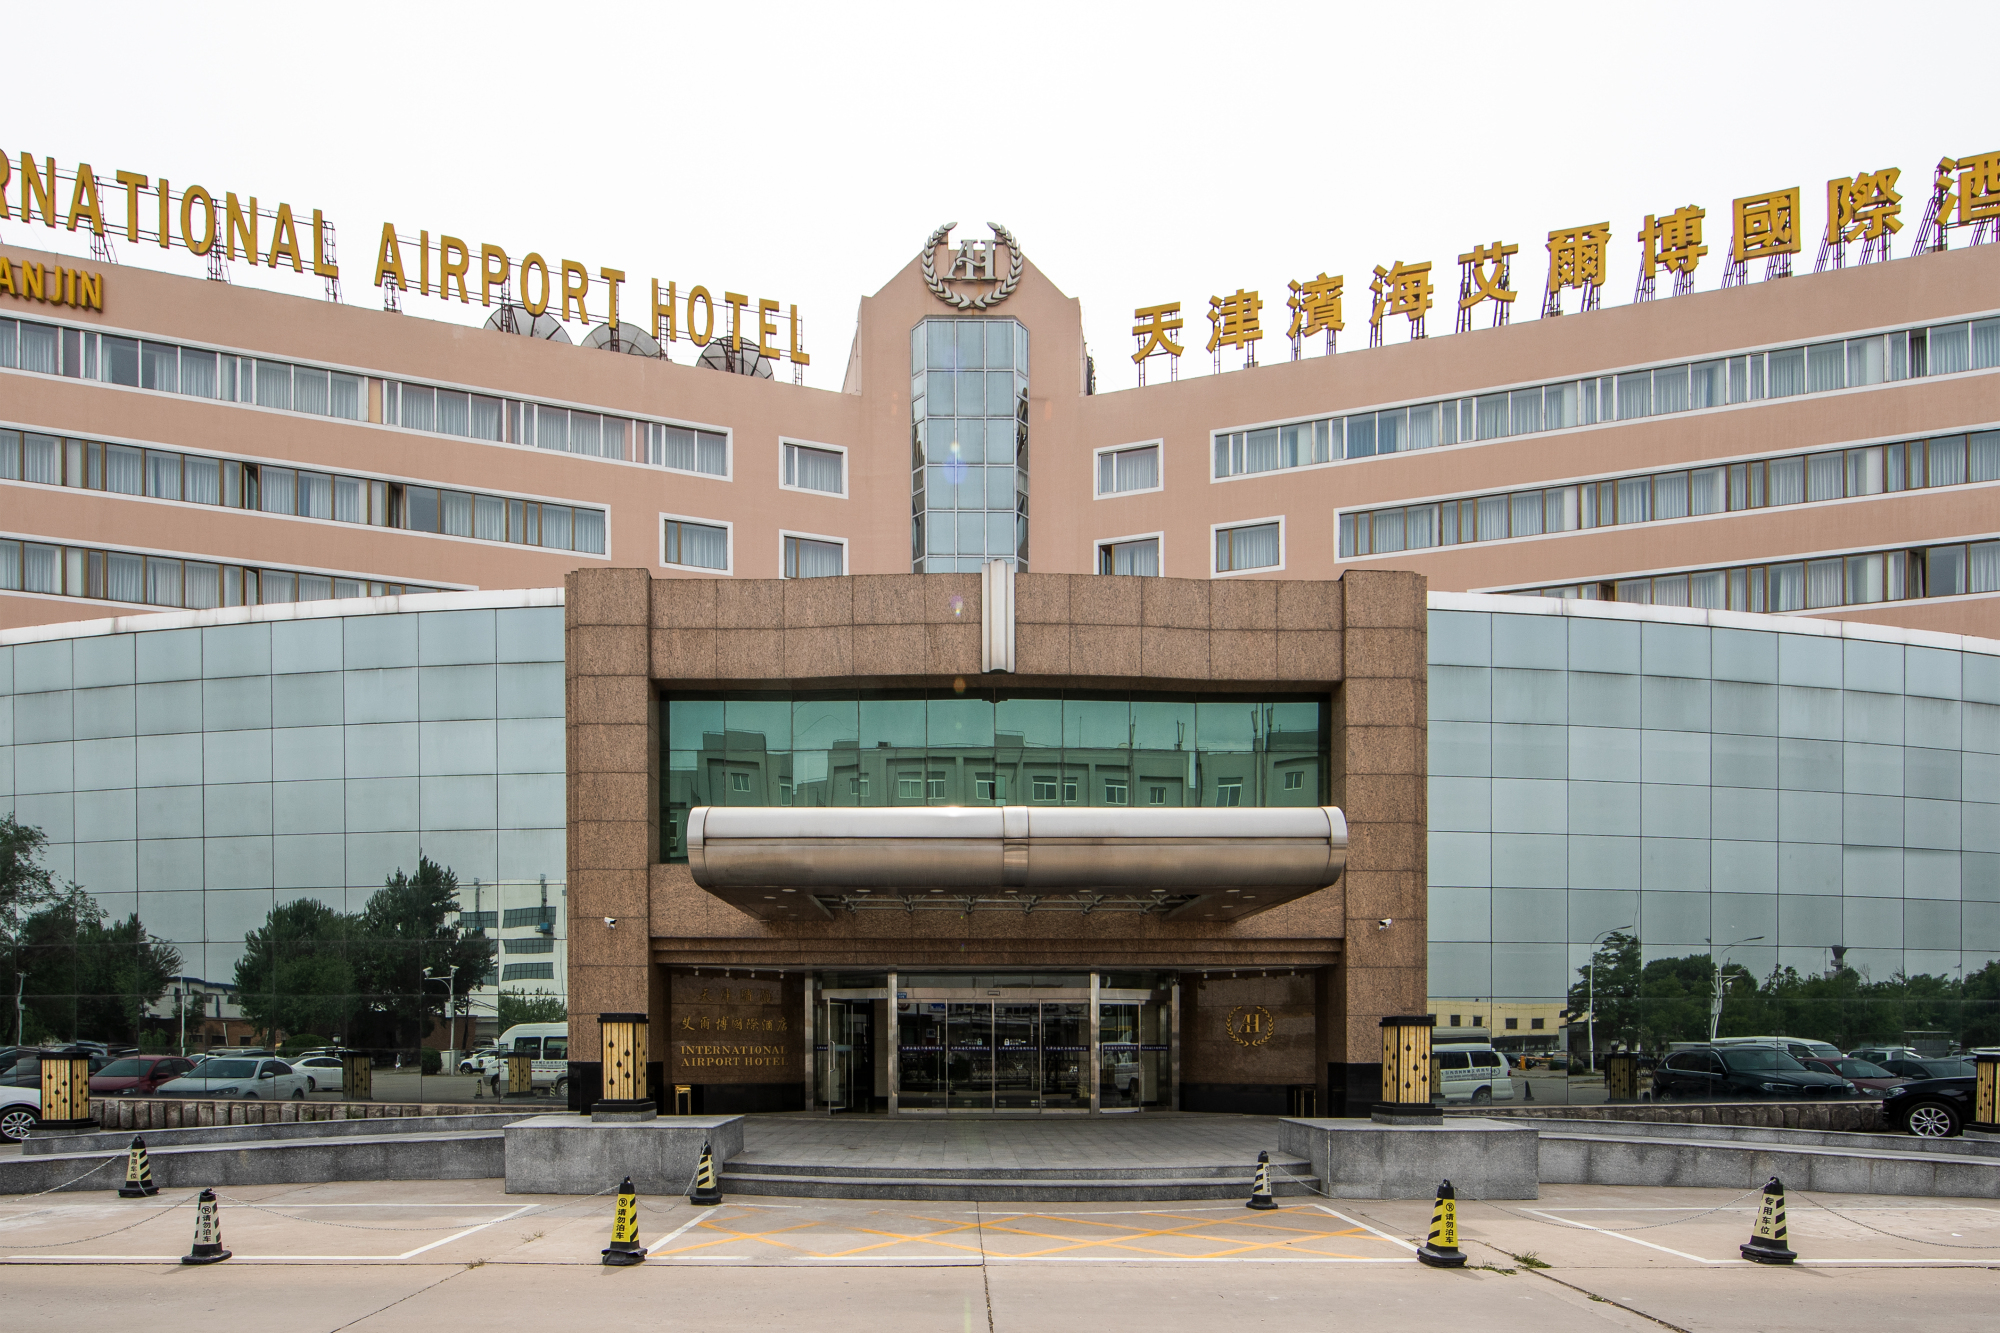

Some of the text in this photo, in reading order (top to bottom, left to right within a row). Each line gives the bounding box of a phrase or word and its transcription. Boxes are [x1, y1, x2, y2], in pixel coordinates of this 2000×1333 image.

[374, 222, 626, 331] AIRPORT
[651, 276, 810, 365] HOTEL
[681, 1045, 788, 1055] INTERNATIONAL
[681, 1057, 789, 1067] AIRPORT HOTEL
[202, 1214, 212, 1243] 请勿泊车
[615, 1208, 627, 1240] 请勿泊车
[1444, 1213, 1454, 1244] 请勿泊车
[1760, 1196, 1774, 1235] 专用车位
